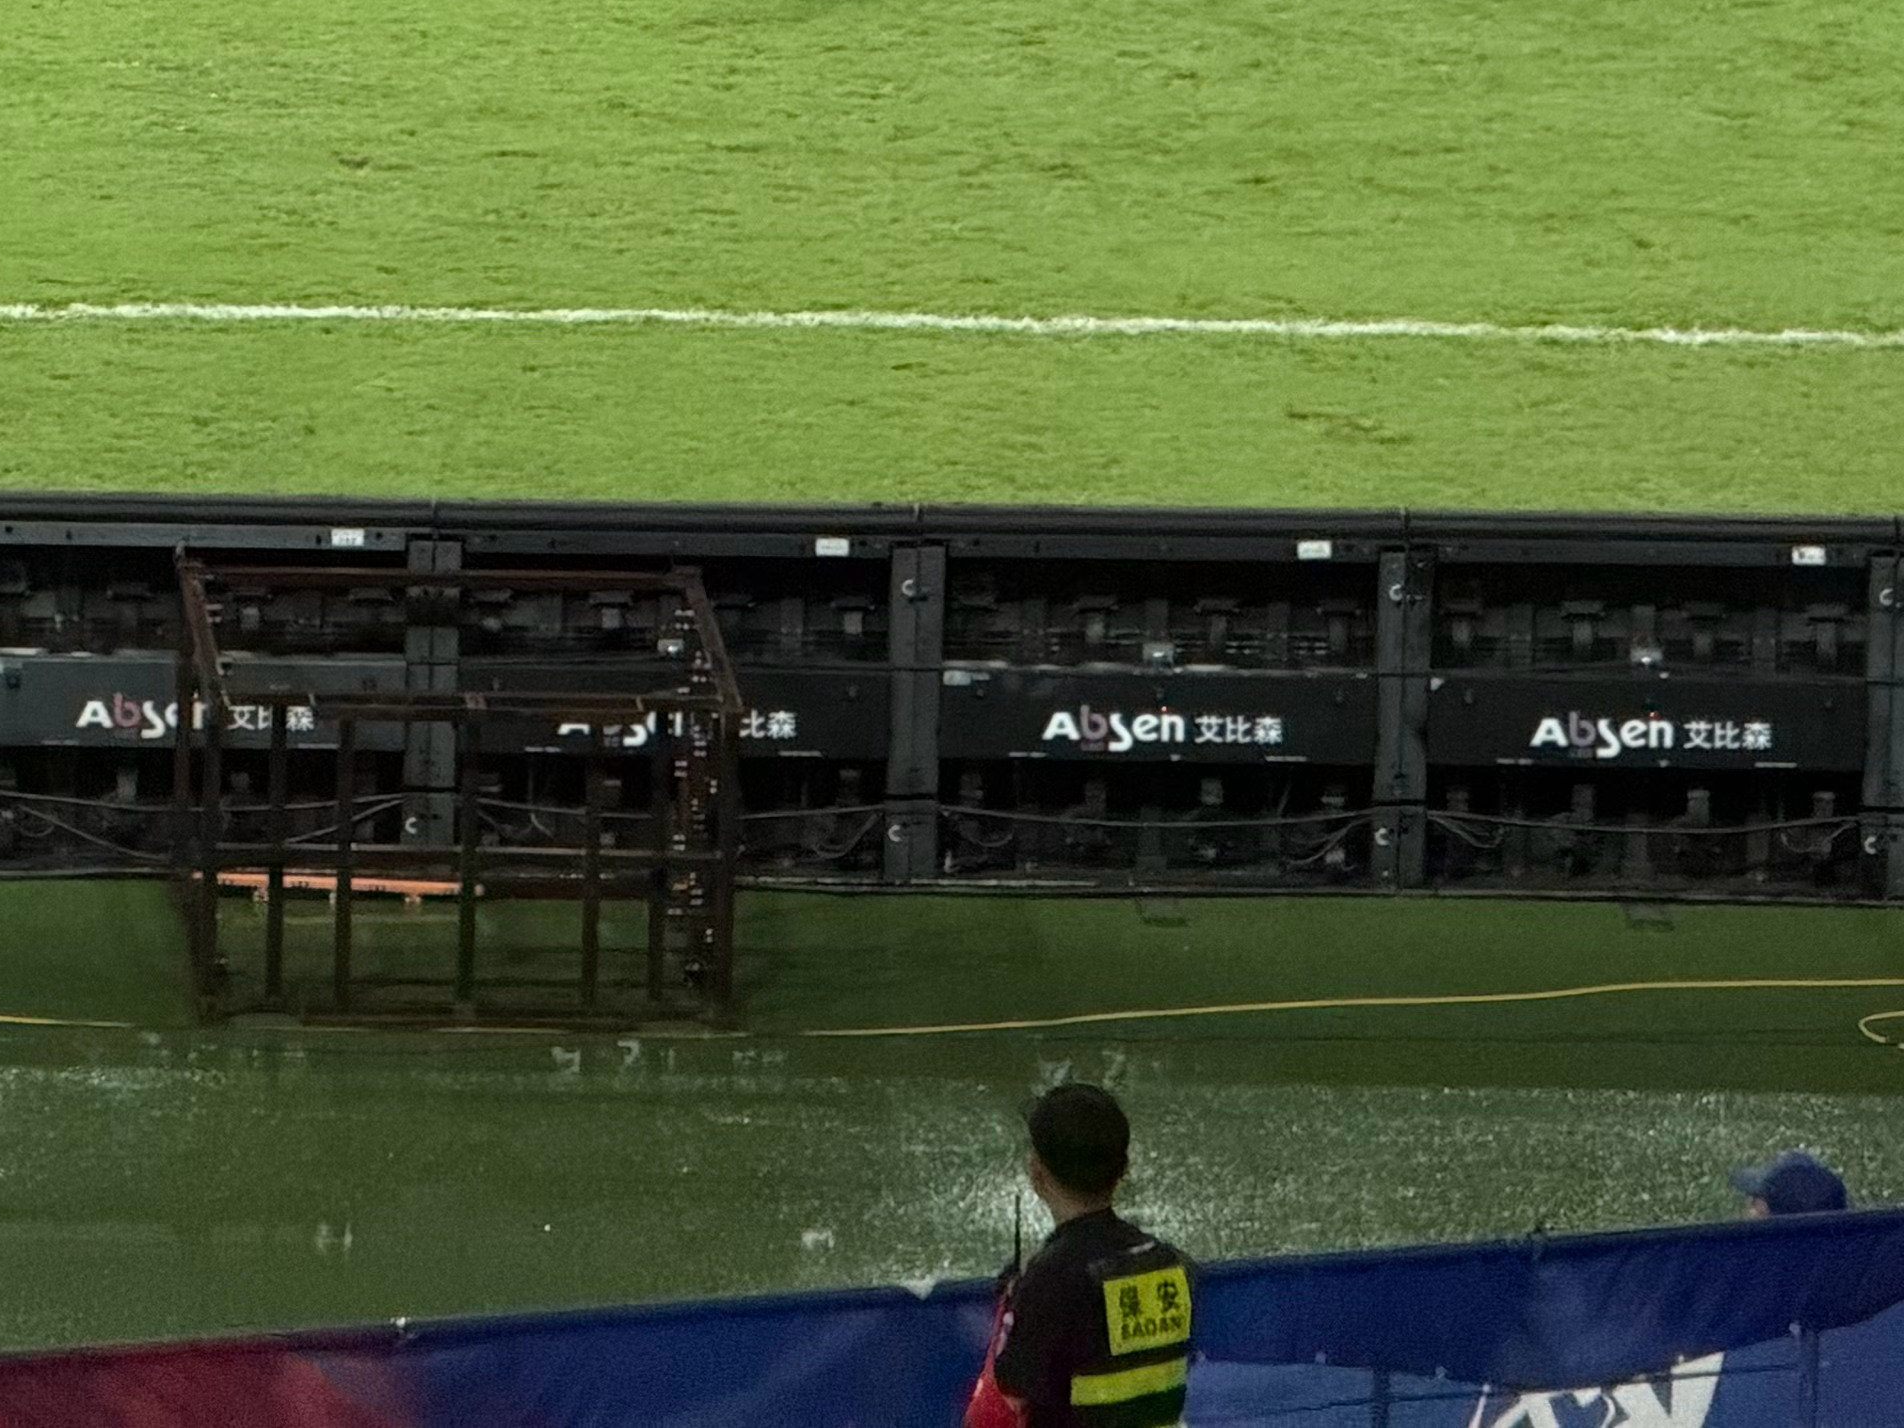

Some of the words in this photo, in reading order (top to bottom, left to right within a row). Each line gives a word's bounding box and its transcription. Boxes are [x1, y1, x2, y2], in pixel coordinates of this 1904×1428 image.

[1042, 705, 1185, 752] Absen
[1195, 715, 1283, 744] 艾比森
[1529, 711, 1675, 758] Absen
[1683, 721, 1773, 750] 艾比森
